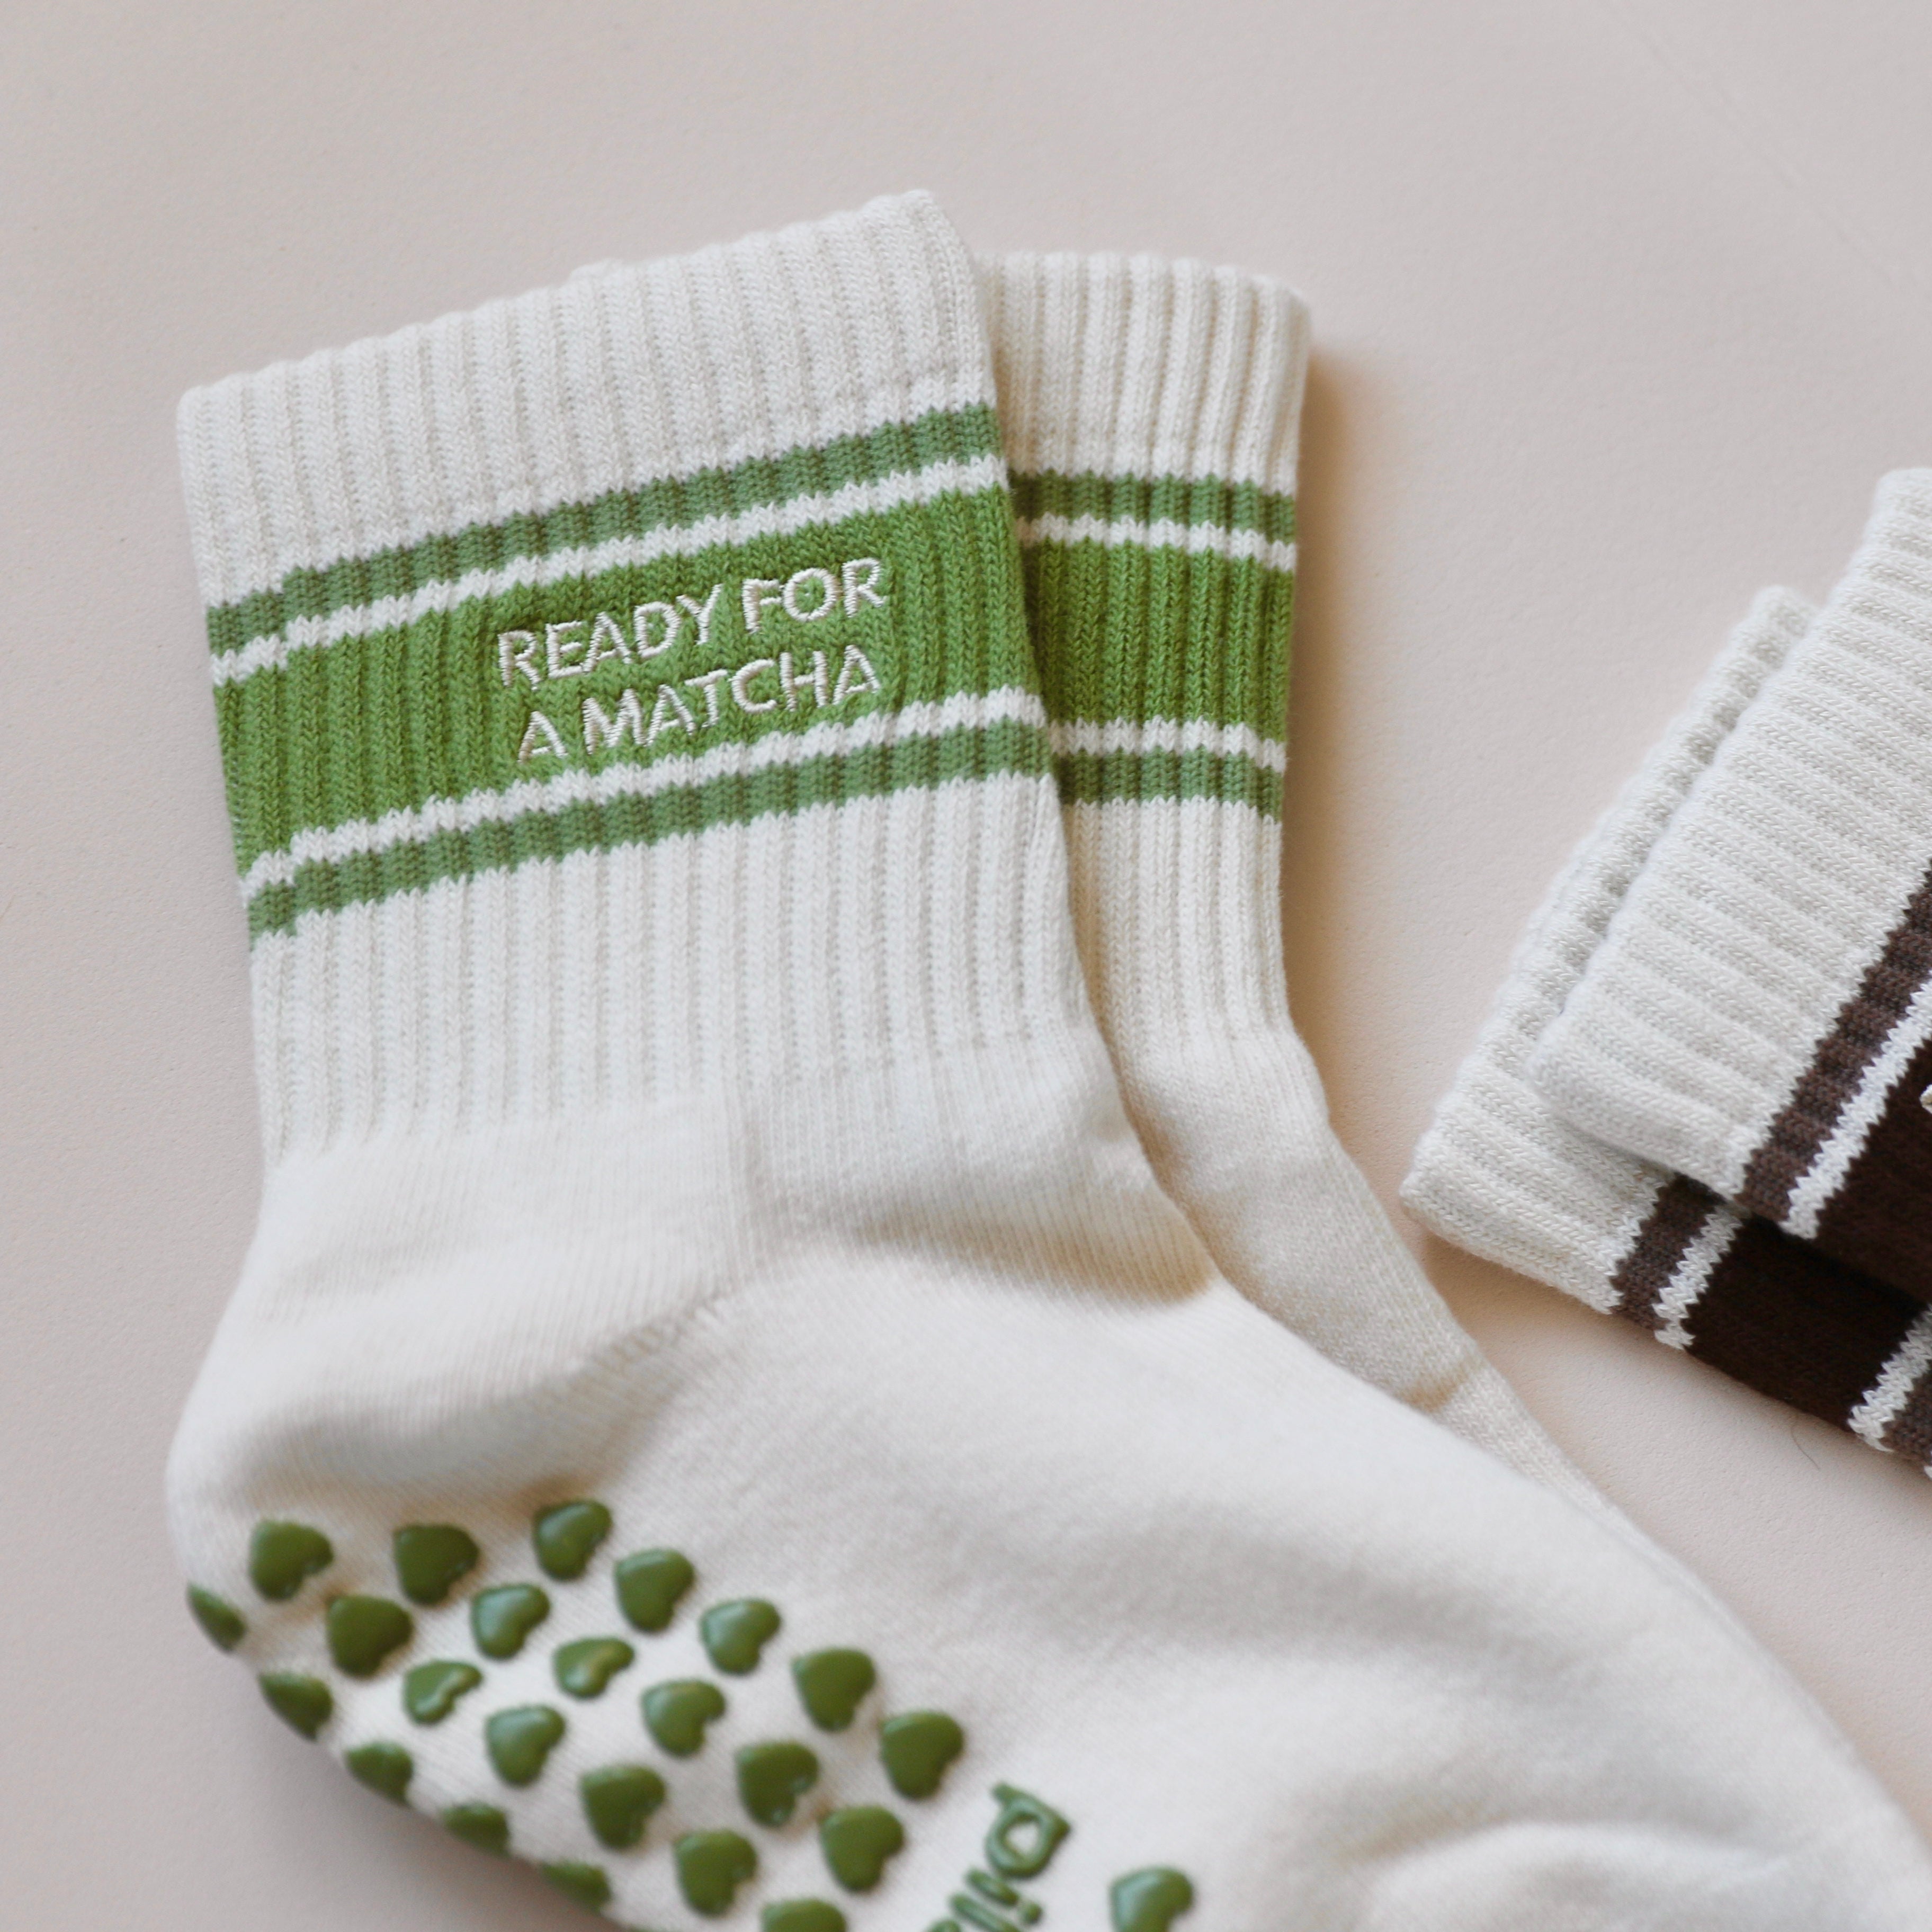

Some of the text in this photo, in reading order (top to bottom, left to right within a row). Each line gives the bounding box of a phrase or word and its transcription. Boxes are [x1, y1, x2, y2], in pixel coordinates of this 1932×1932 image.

[498, 558, 887, 690] READY FOR
[518, 645, 881, 763] A MATCHA
[924, 1782, 1071, 1932] pil
